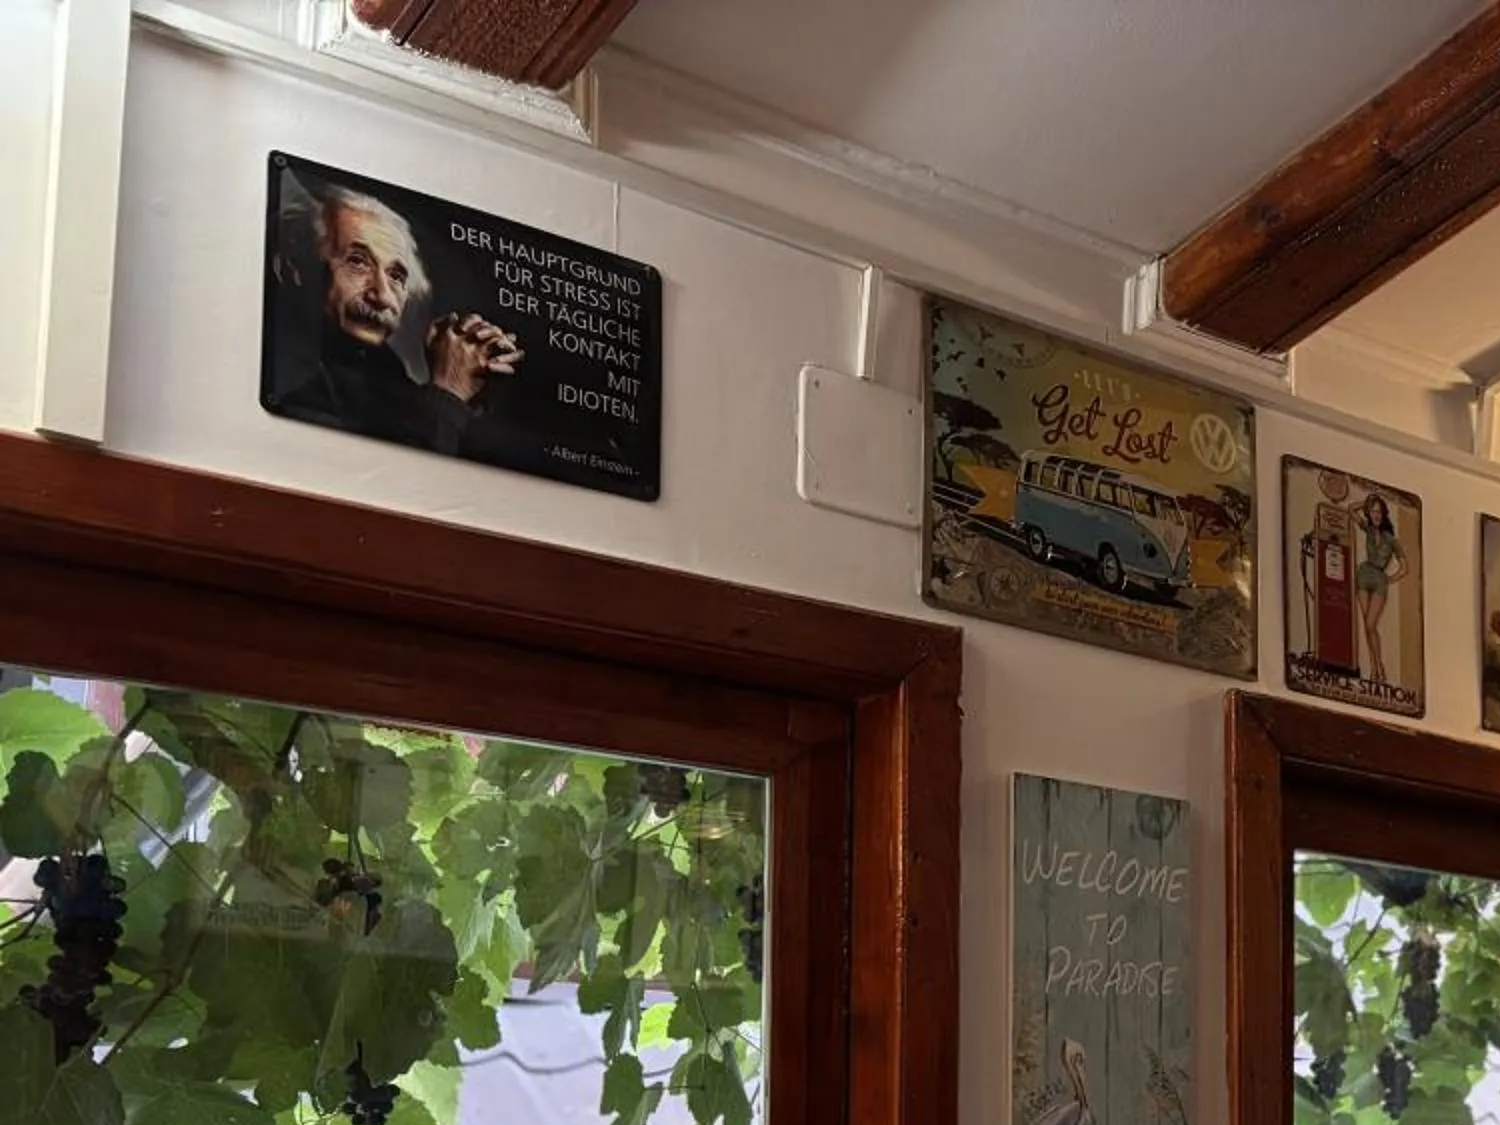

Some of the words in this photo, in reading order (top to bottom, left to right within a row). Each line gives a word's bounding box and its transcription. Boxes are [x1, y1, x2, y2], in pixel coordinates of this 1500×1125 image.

[451, 223, 493, 250] DER
[499, 237, 641, 295] HAUPTGRUND
[494, 260, 533, 288] FÜR
[540, 274, 611, 311] STRESS
[617, 297, 641, 321] IST
[499, 287, 539, 316] DER
[546, 301, 641, 348] TÄGLICHE
[549, 329, 641, 371] KONTAKT
[558, 383, 639, 424] IDIOTEN.
[608, 371, 641, 396] MIT
[1032, 384, 1106, 445] Get
[1102, 408, 1178, 463] Lost
[1360, 679, 1417, 705] STATION
[1022, 839, 1189, 903] WELCOME
[1085, 913, 1127, 945] TO
[1045, 945, 1179, 999] PARADISE
